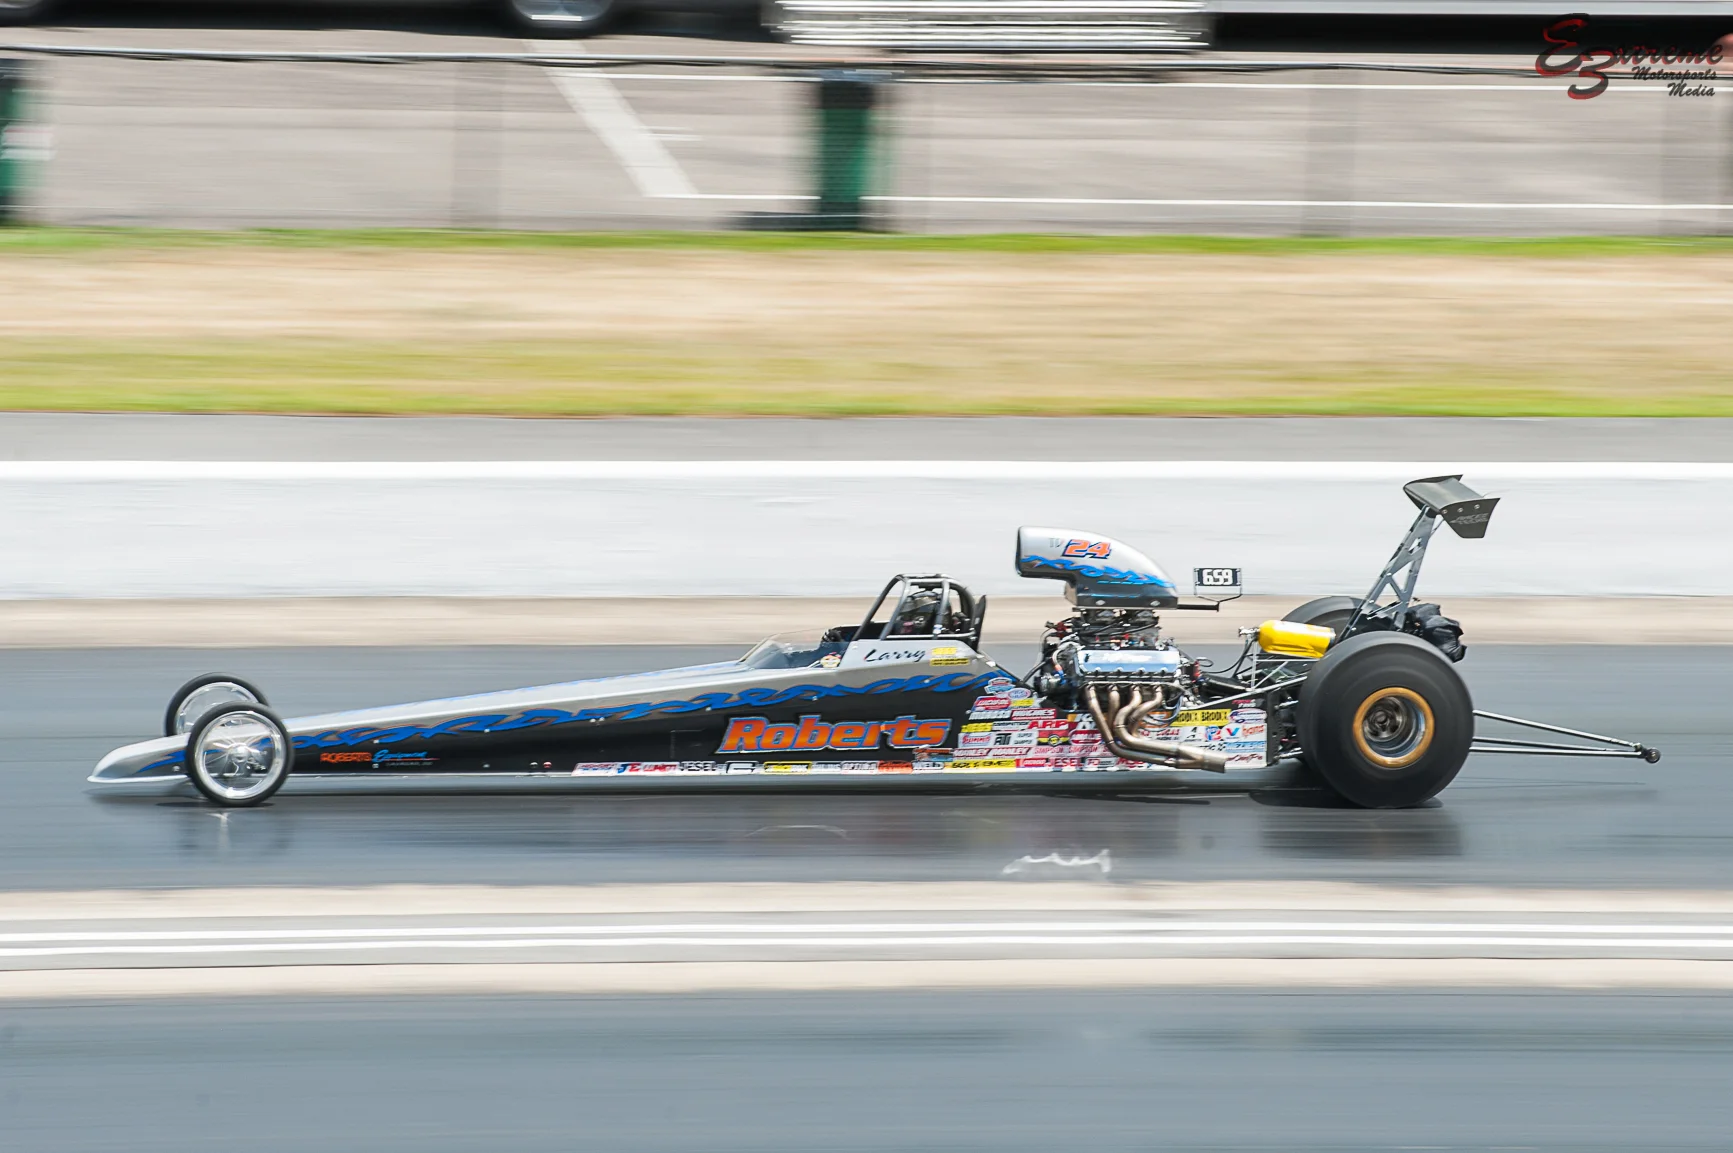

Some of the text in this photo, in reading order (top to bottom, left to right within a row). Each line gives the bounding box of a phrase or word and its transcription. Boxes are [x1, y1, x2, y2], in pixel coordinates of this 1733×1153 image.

[1061, 539, 1112, 559] 24
[864, 648, 926, 664] Larry
[717, 715, 951, 756] Roberts
